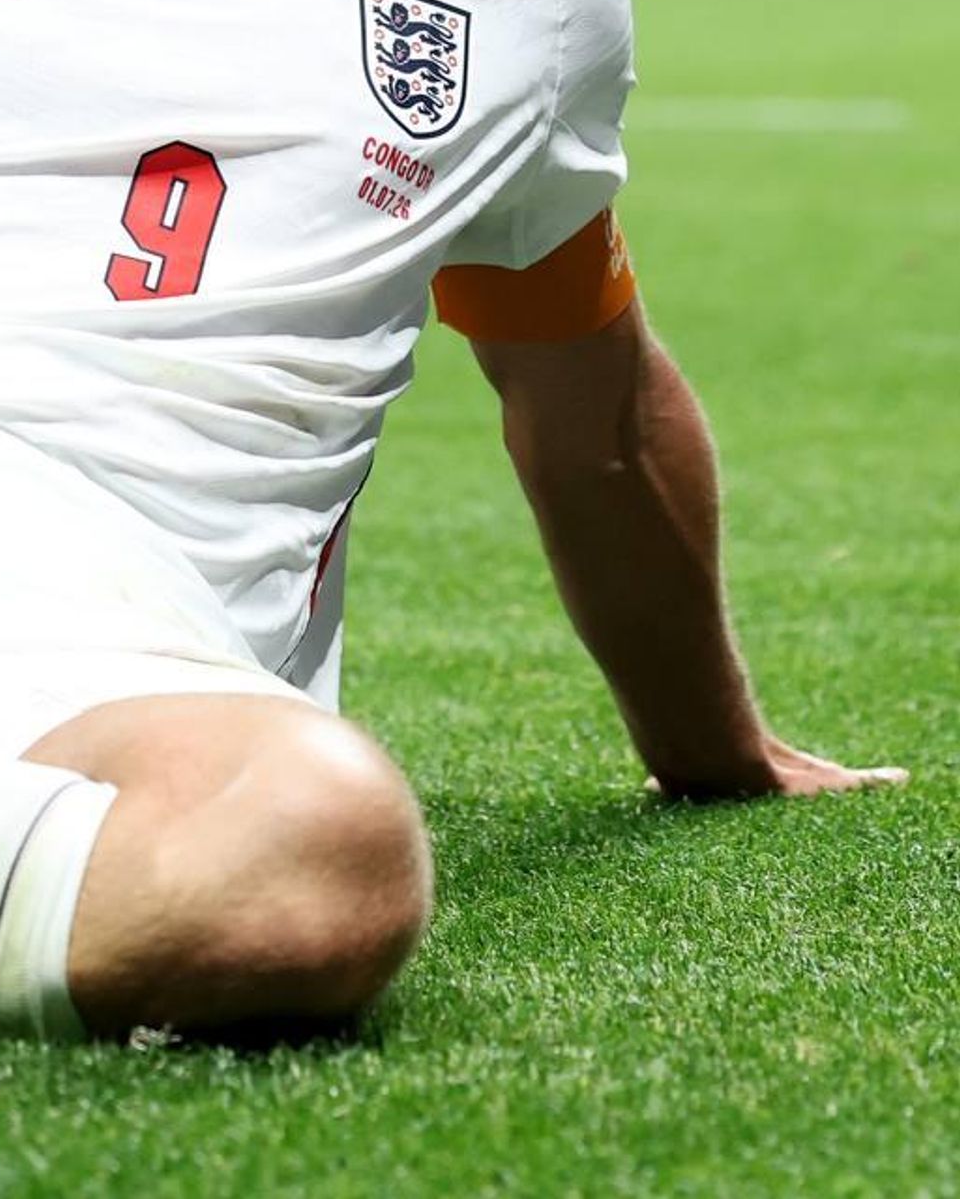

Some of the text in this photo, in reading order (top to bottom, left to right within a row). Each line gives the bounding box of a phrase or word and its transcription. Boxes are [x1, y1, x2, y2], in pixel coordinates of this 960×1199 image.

[362, 137, 419, 182] CONGO
[104, 140, 227, 301] 9
[358, 176, 411, 220] 01.07.26
